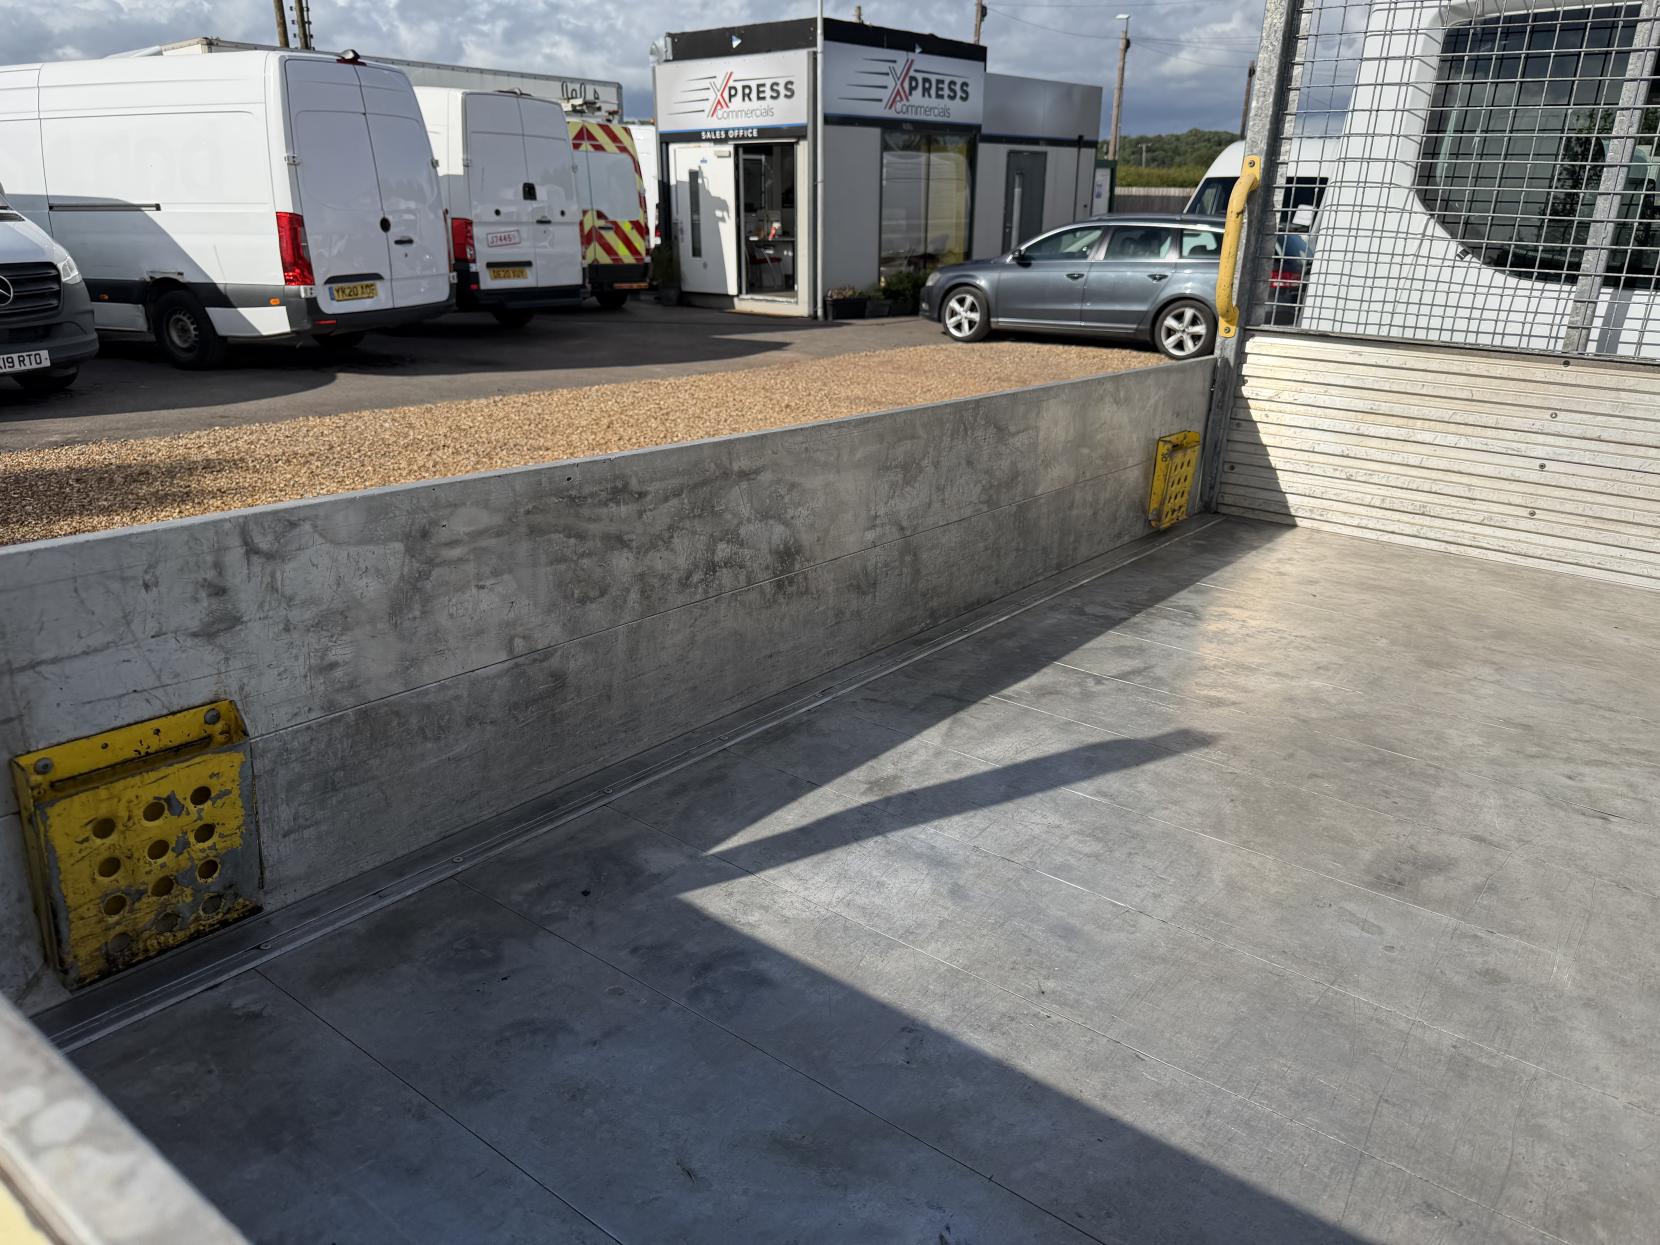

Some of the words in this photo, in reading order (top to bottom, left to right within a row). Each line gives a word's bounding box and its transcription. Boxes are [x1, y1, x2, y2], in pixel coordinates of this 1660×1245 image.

[884, 58, 970, 110] XPRESS
[707, 71, 795, 118] XPRESS
[716, 104, 775, 120] Commercials
[894, 102, 951, 118] Commercials
[701, 130, 726, 139] SALES
[728, 128, 758, 138] OFFICE
[17, 352, 43, 368] RTO
